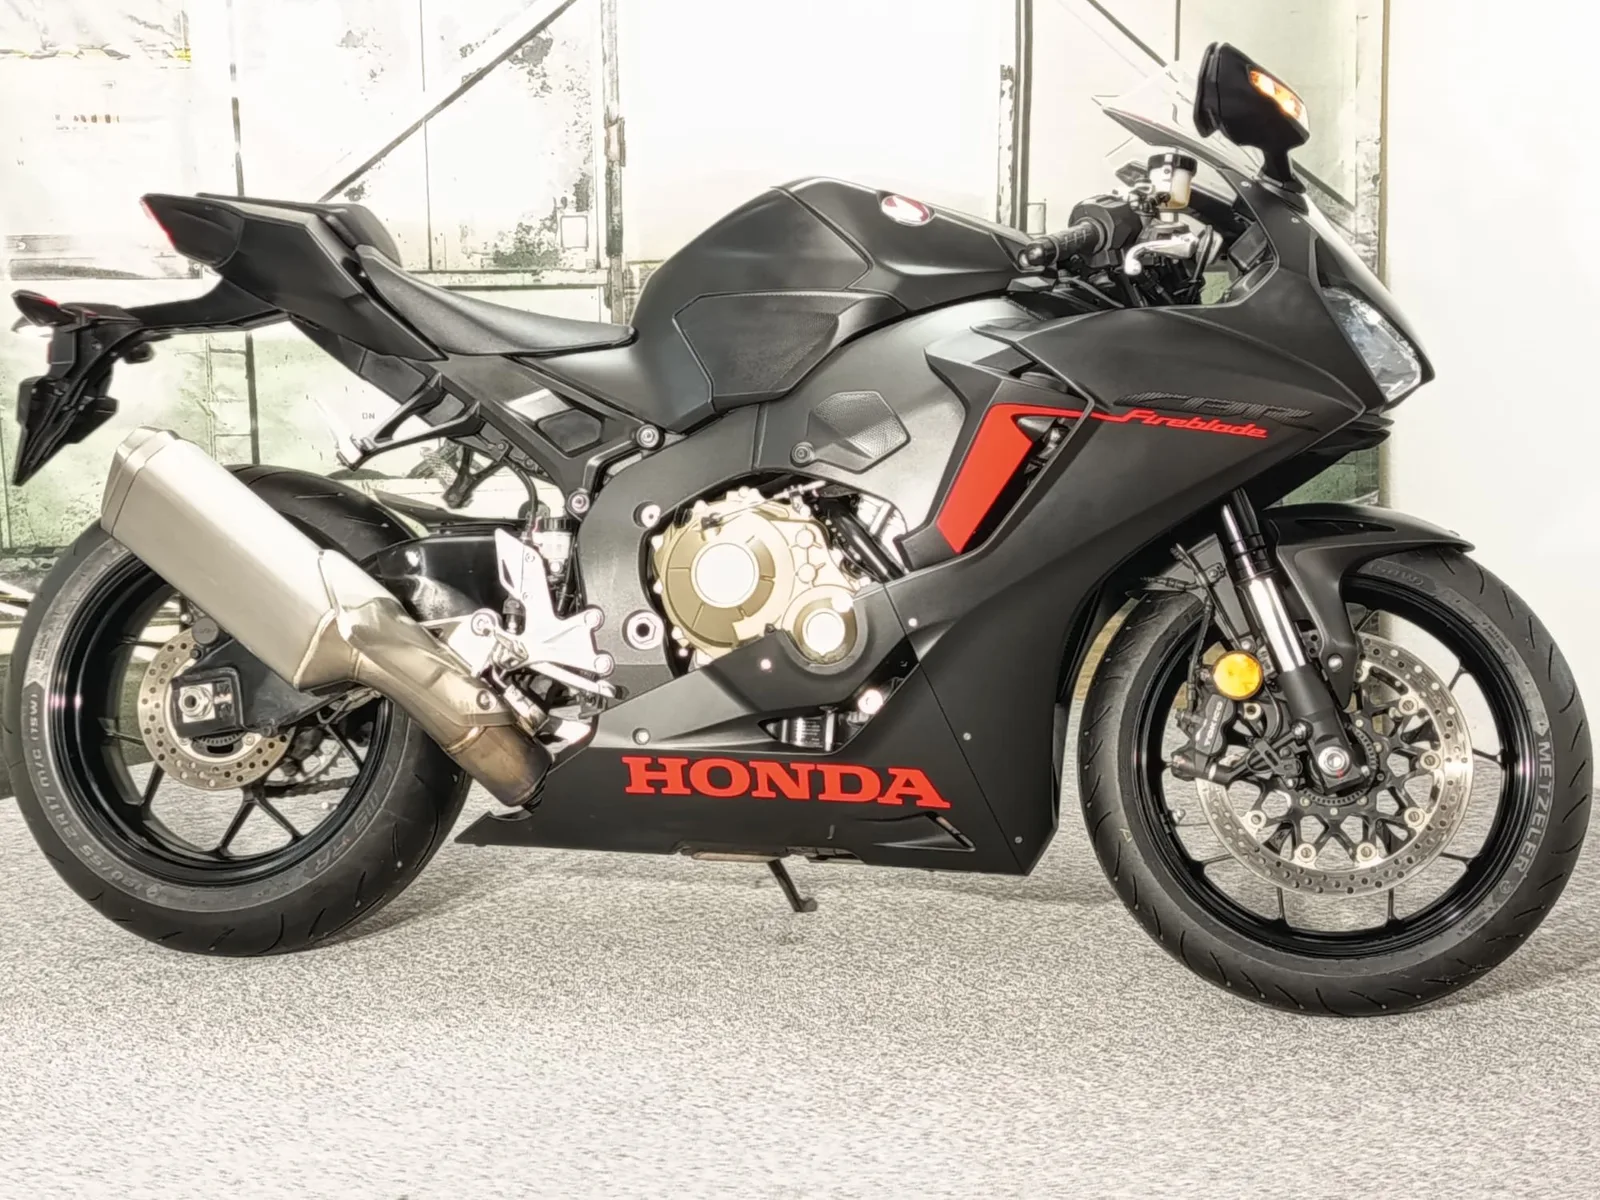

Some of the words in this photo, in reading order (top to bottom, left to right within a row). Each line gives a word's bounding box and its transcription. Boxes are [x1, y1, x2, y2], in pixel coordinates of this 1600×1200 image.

[1121, 408, 1268, 439] Fireblade
[1203, 700, 1224, 747] TOKICO
[621, 755, 952, 810] HONDA
[1512, 741, 1552, 874] METZELER
